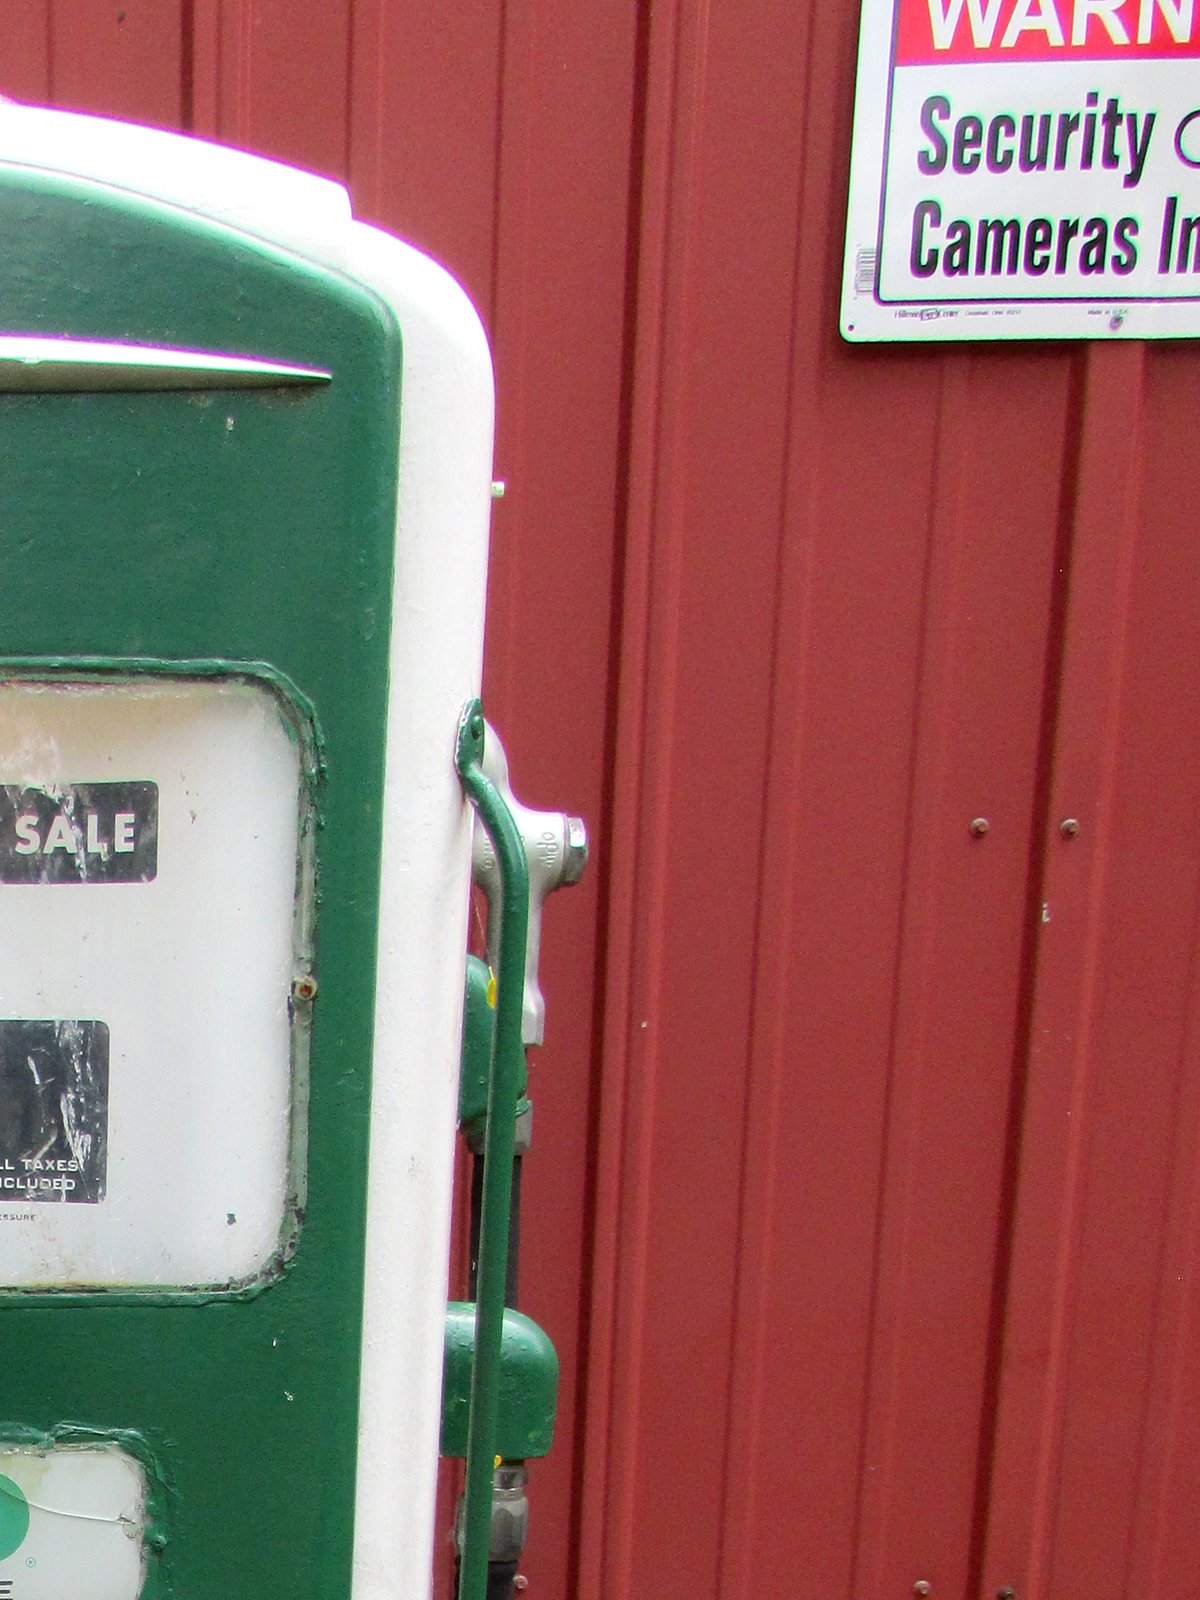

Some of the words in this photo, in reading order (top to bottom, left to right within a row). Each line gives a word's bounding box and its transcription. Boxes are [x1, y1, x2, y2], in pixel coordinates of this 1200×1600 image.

[928, 0, 1194, 50] WARN
[917, 92, 1156, 189] Security
[909, 200, 1139, 278] Cameras
[14, 813, 135, 855] SALE
[21, 1159, 79, 1172] TAXES
